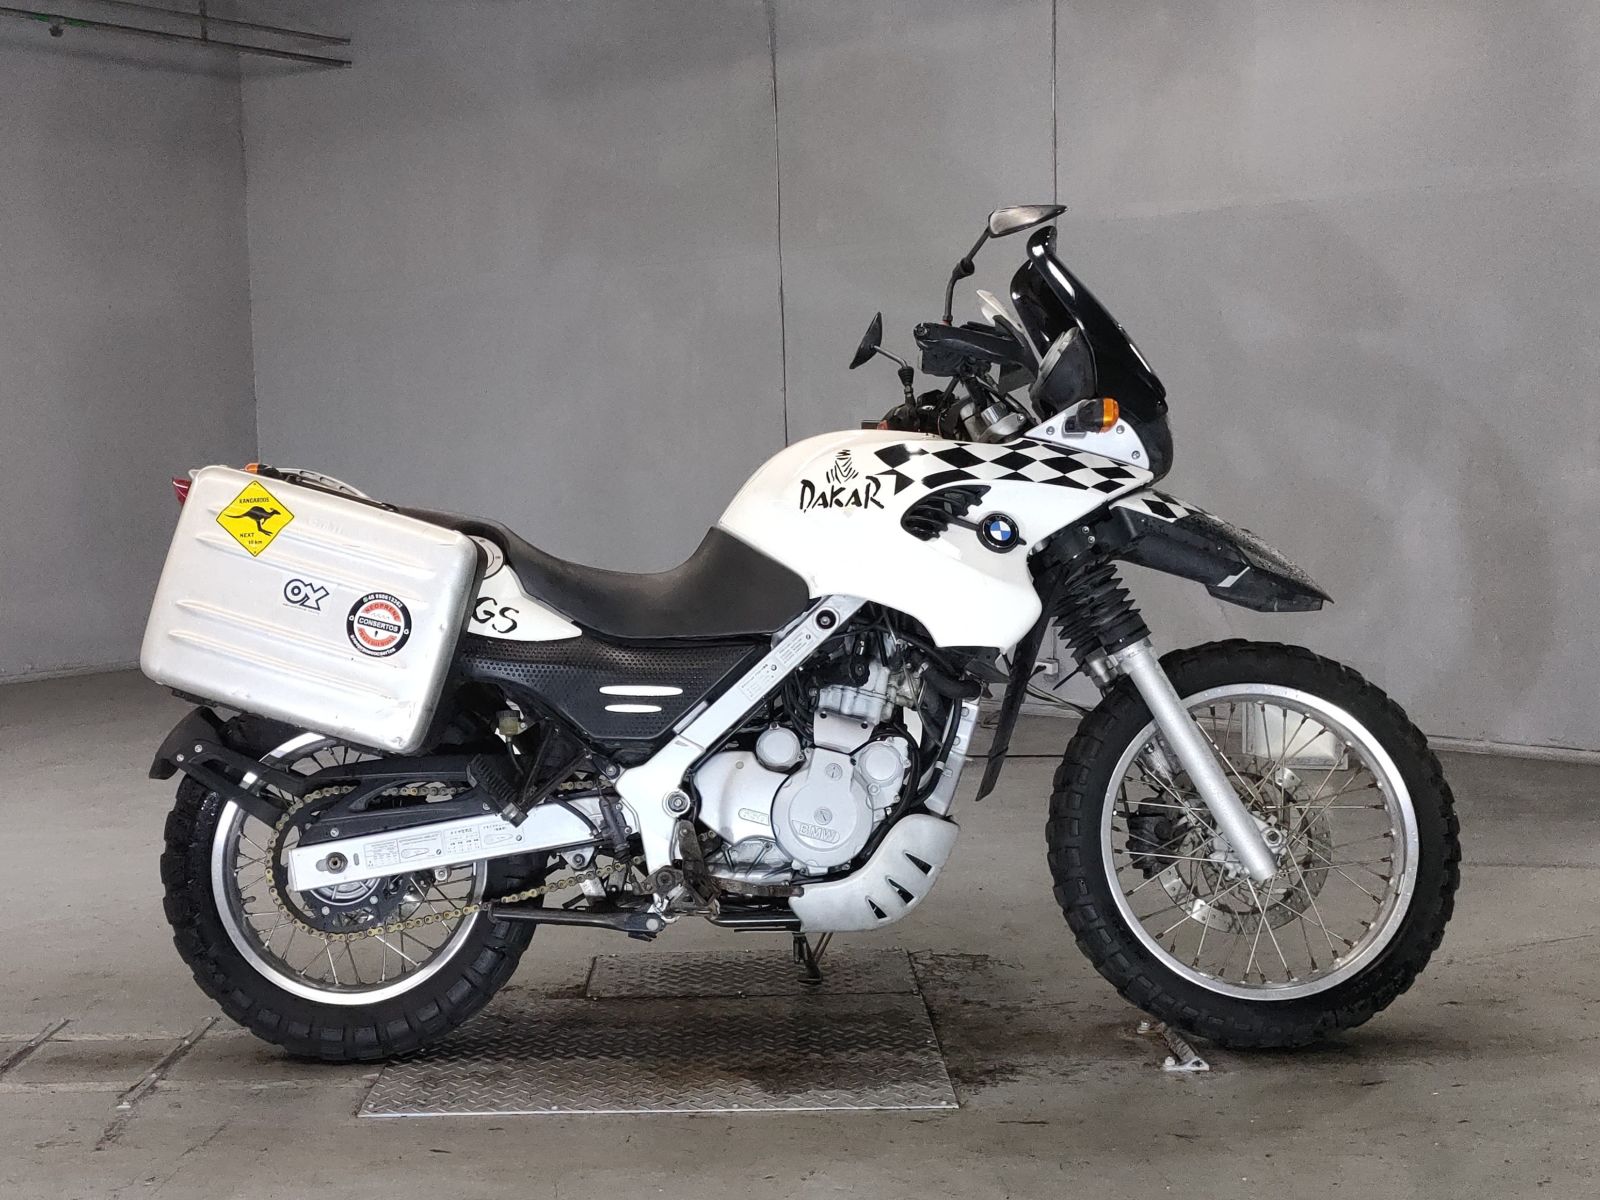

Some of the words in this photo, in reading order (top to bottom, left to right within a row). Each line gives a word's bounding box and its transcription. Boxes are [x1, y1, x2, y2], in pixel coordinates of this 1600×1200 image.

[799, 475, 884, 513] DAKAR
[358, 617, 399, 632] CONSERTOS
[471, 597, 519, 634] GS
[800, 823, 839, 842] BMW
